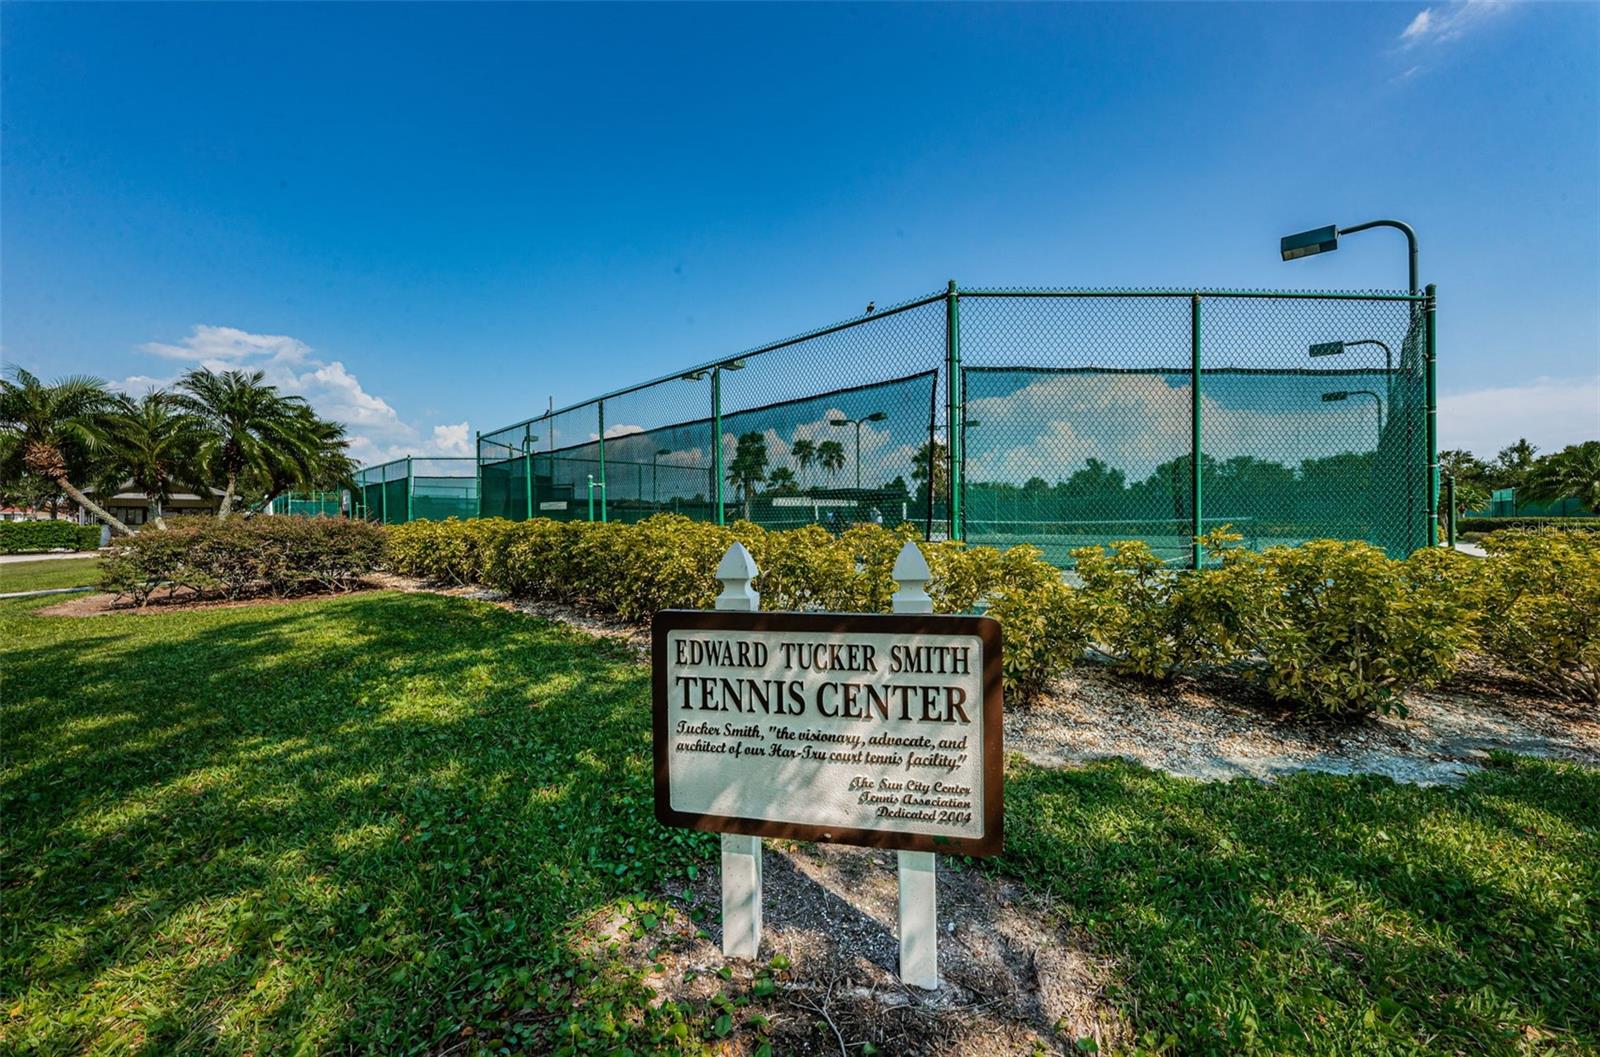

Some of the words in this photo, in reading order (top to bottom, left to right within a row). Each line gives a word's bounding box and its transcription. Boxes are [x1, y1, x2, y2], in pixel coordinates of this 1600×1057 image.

[675, 639, 768, 668] EDWARD
[780, 642, 878, 673] TUCKER
[890, 645, 971, 675] SMITH
[675, 676, 806, 716] TENNIS
[816, 681, 971, 724] CENTER
[676, 720, 720, 736] Tucker
[723, 723, 765, 741] Smith,
[769, 726, 796, 741] "the
[798, 729, 866, 750] visionary,
[868, 732, 936, 750] advocate,
[938, 736, 968, 750] and
[676, 739, 727, 754] architect
[728, 741, 742, 758] of
[744, 747, 765, 756] our
[767, 743, 827, 761] Har-Tru
[829, 751, 862, 764] court
[865, 751, 902, 765] tennis
[850, 776, 875, 790] The
[878, 778, 903, 791] Sun
[906, 780, 931, 795] City
[934, 781, 971, 796] Center
[860, 791, 899, 804] Tennis
[902, 793, 971, 810] Association
[877, 805, 937, 821] Dedicated
[938, 810, 973, 824] 2004
